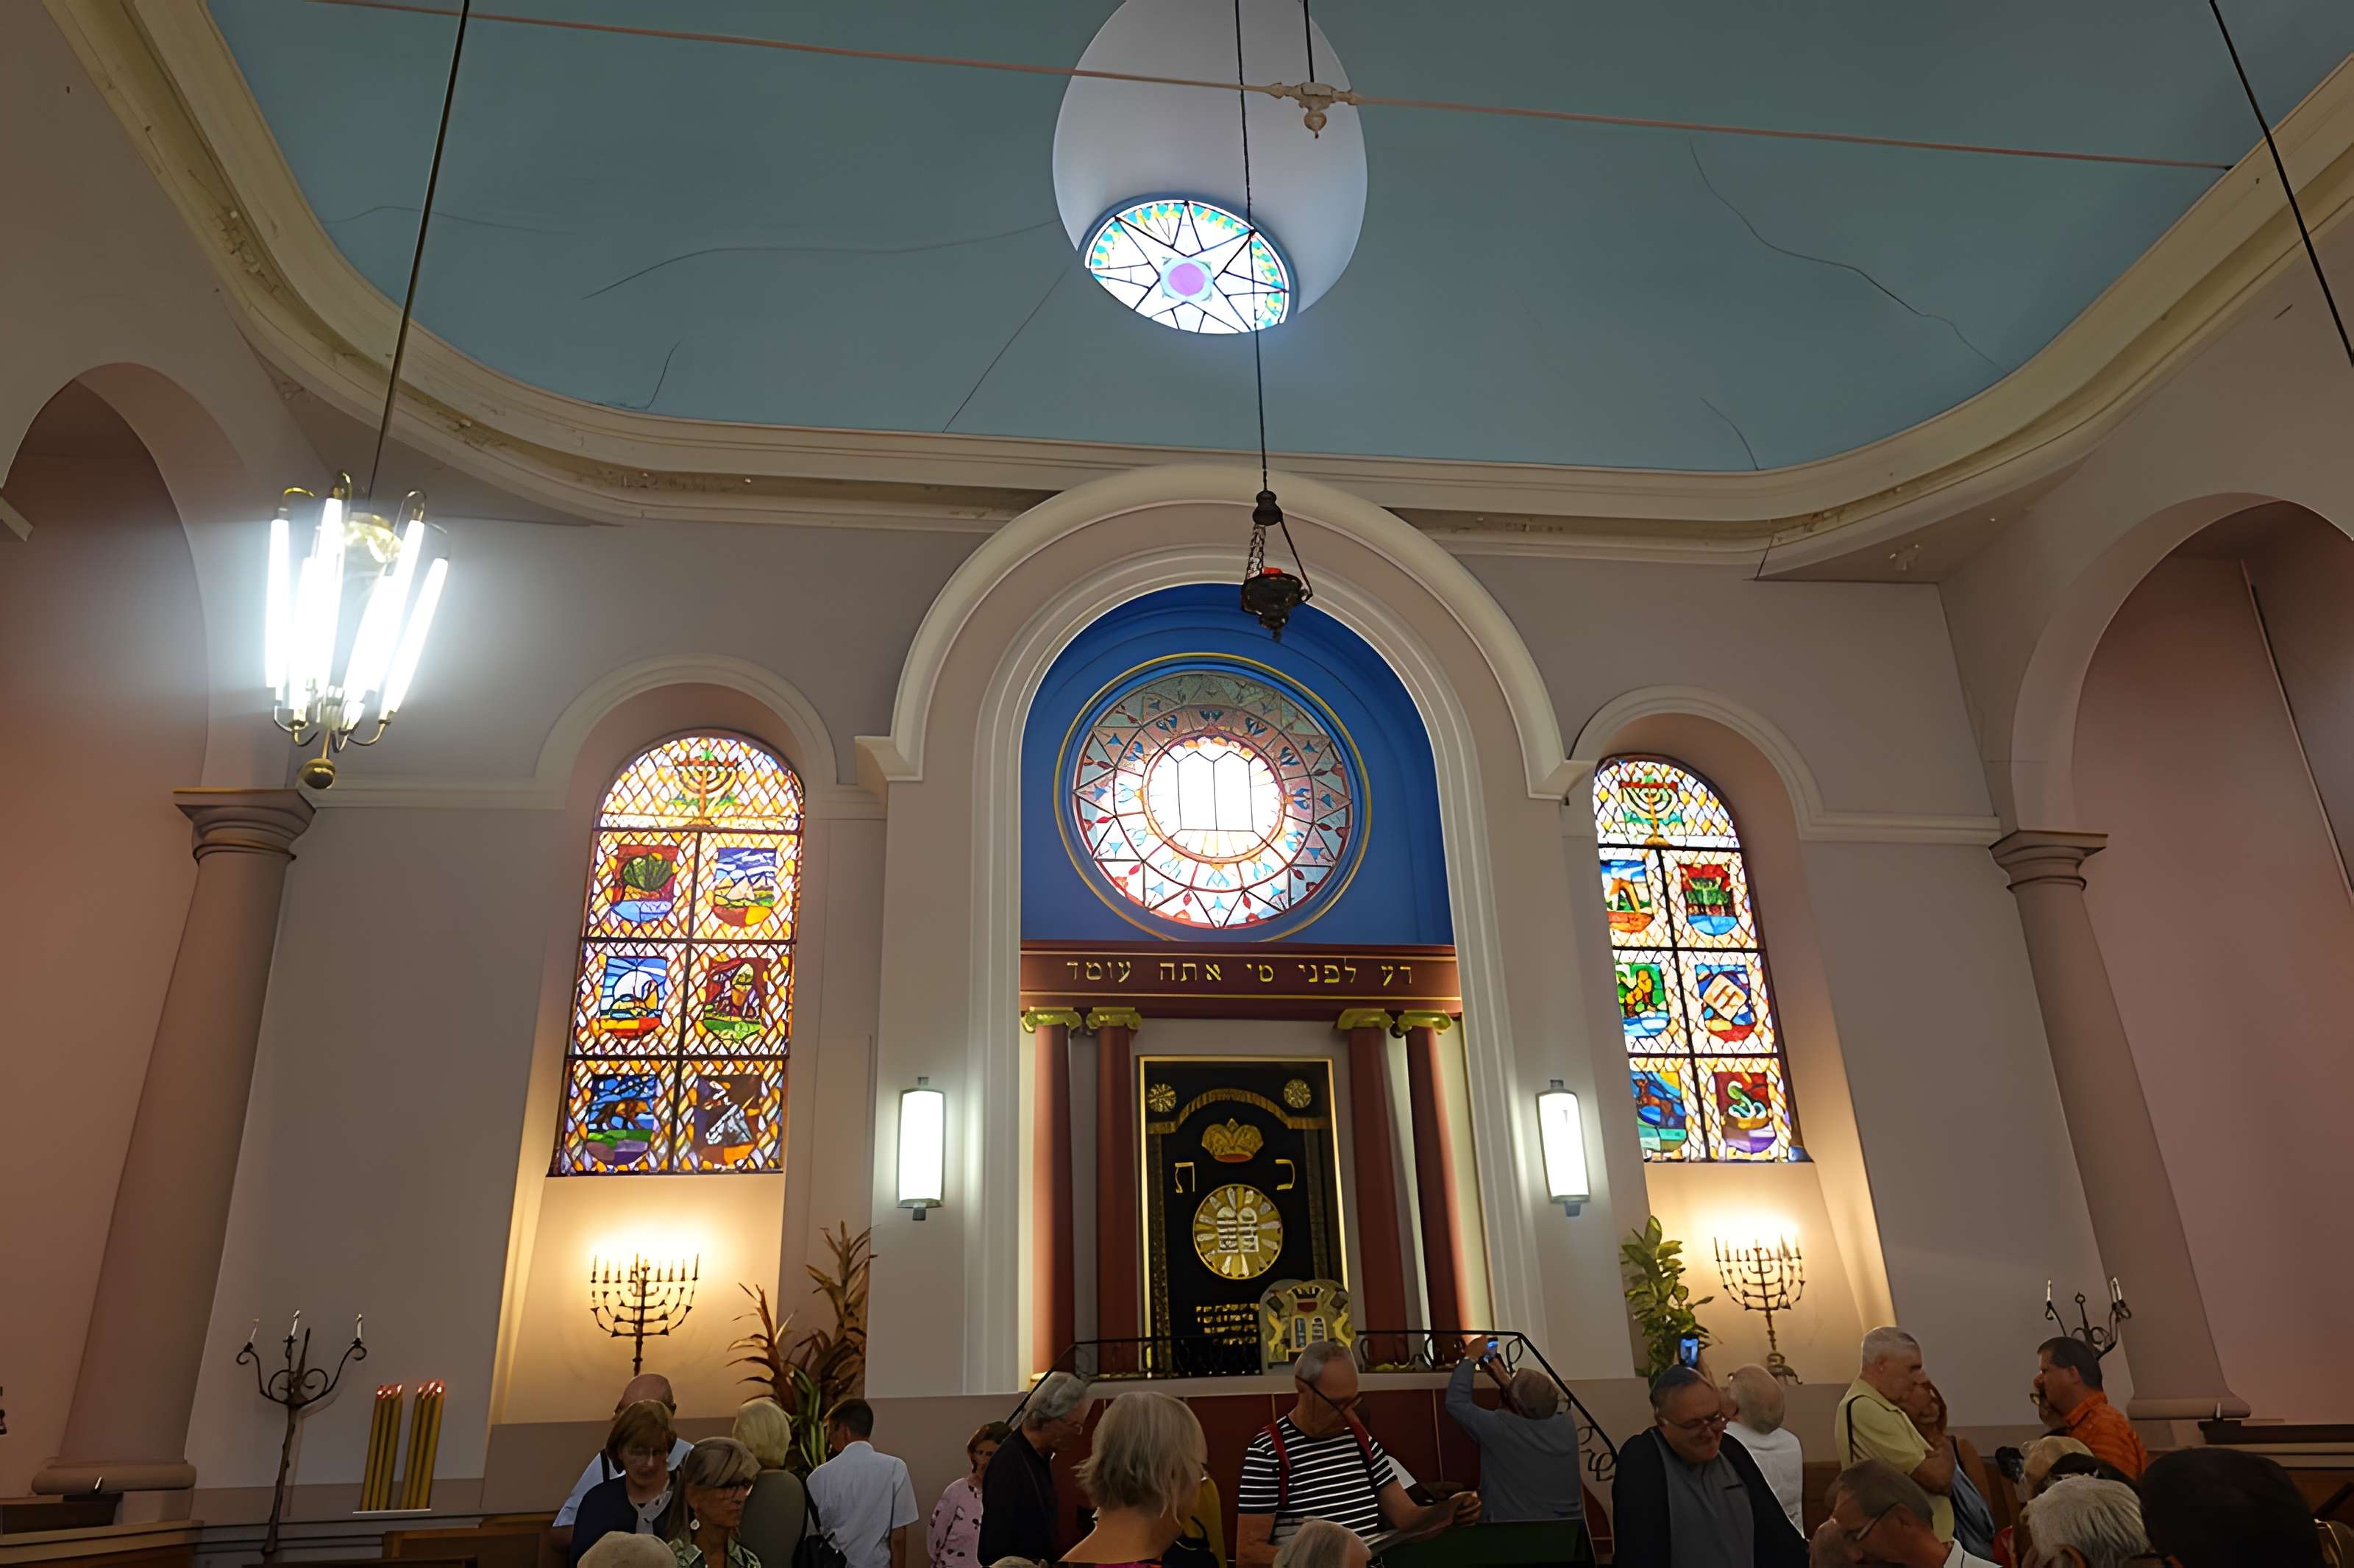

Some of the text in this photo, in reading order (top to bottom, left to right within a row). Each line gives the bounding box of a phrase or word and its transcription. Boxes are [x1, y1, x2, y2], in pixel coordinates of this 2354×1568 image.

[1067, 961, 1131, 983] עומד
[1159, 963, 1221, 981] אתה
[1298, 957, 1356, 983] לפני
[1381, 965, 1412, 986] דע
[1175, 1162, 1195, 1193] ת
